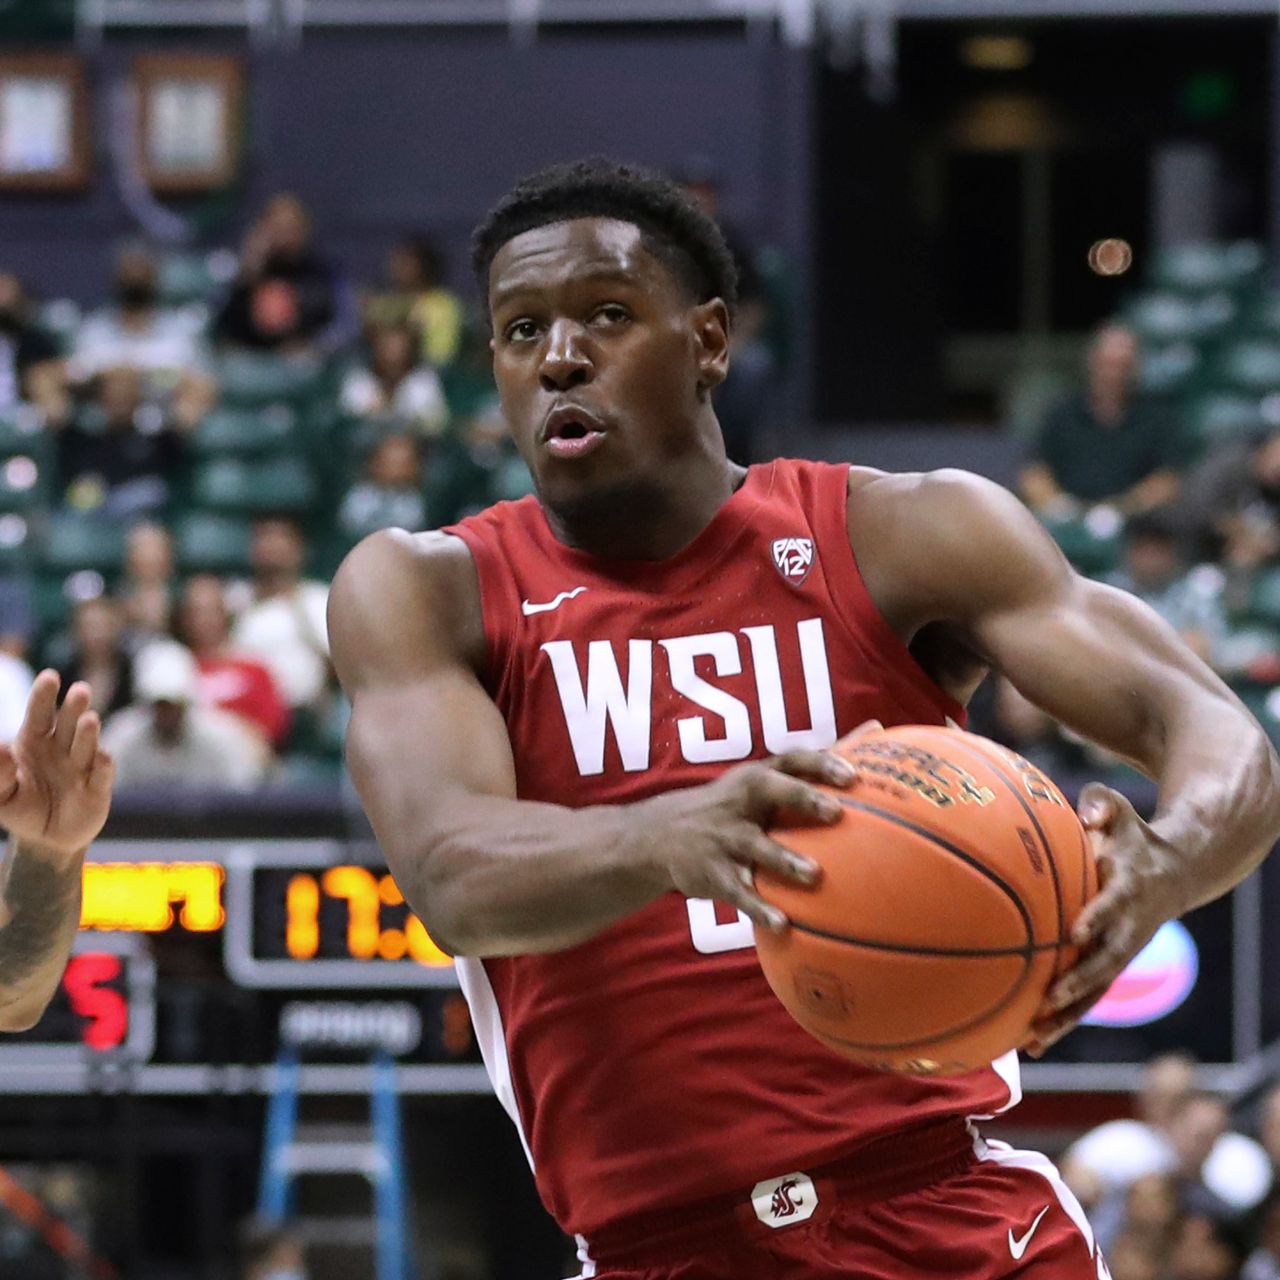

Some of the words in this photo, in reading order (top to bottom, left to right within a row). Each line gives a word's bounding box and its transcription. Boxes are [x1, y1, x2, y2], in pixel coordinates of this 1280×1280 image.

[773, 537, 813, 567] PAC
[783, 556, 806, 576] 12
[540, 617, 838, 776] WSU
